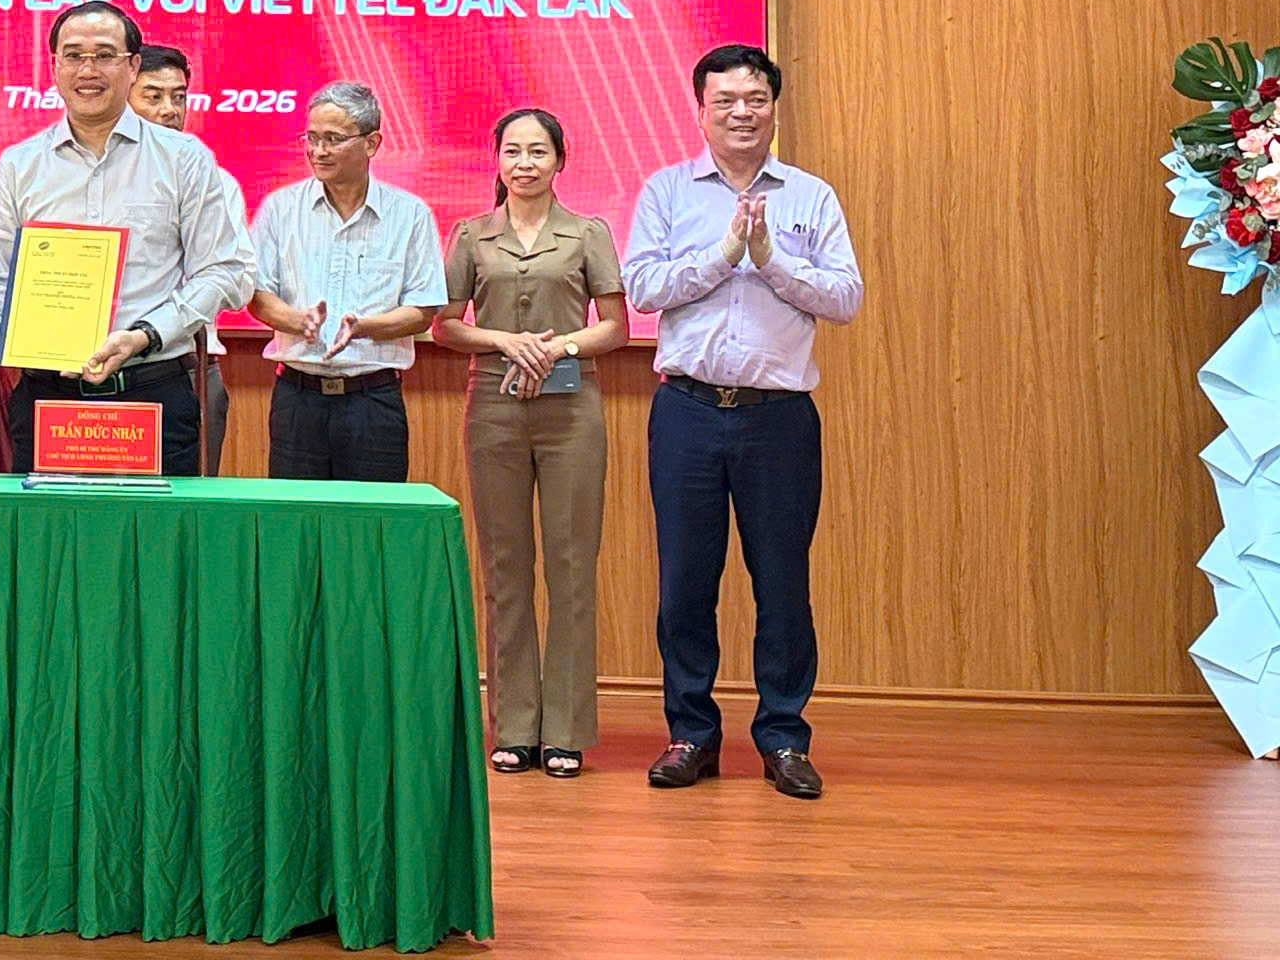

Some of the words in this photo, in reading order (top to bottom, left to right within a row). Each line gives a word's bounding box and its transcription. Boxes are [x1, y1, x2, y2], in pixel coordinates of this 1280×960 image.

[5, 85, 65, 110] Thá
[216, 89, 297, 113] 2026
[112, 424, 145, 443] NHẬT
